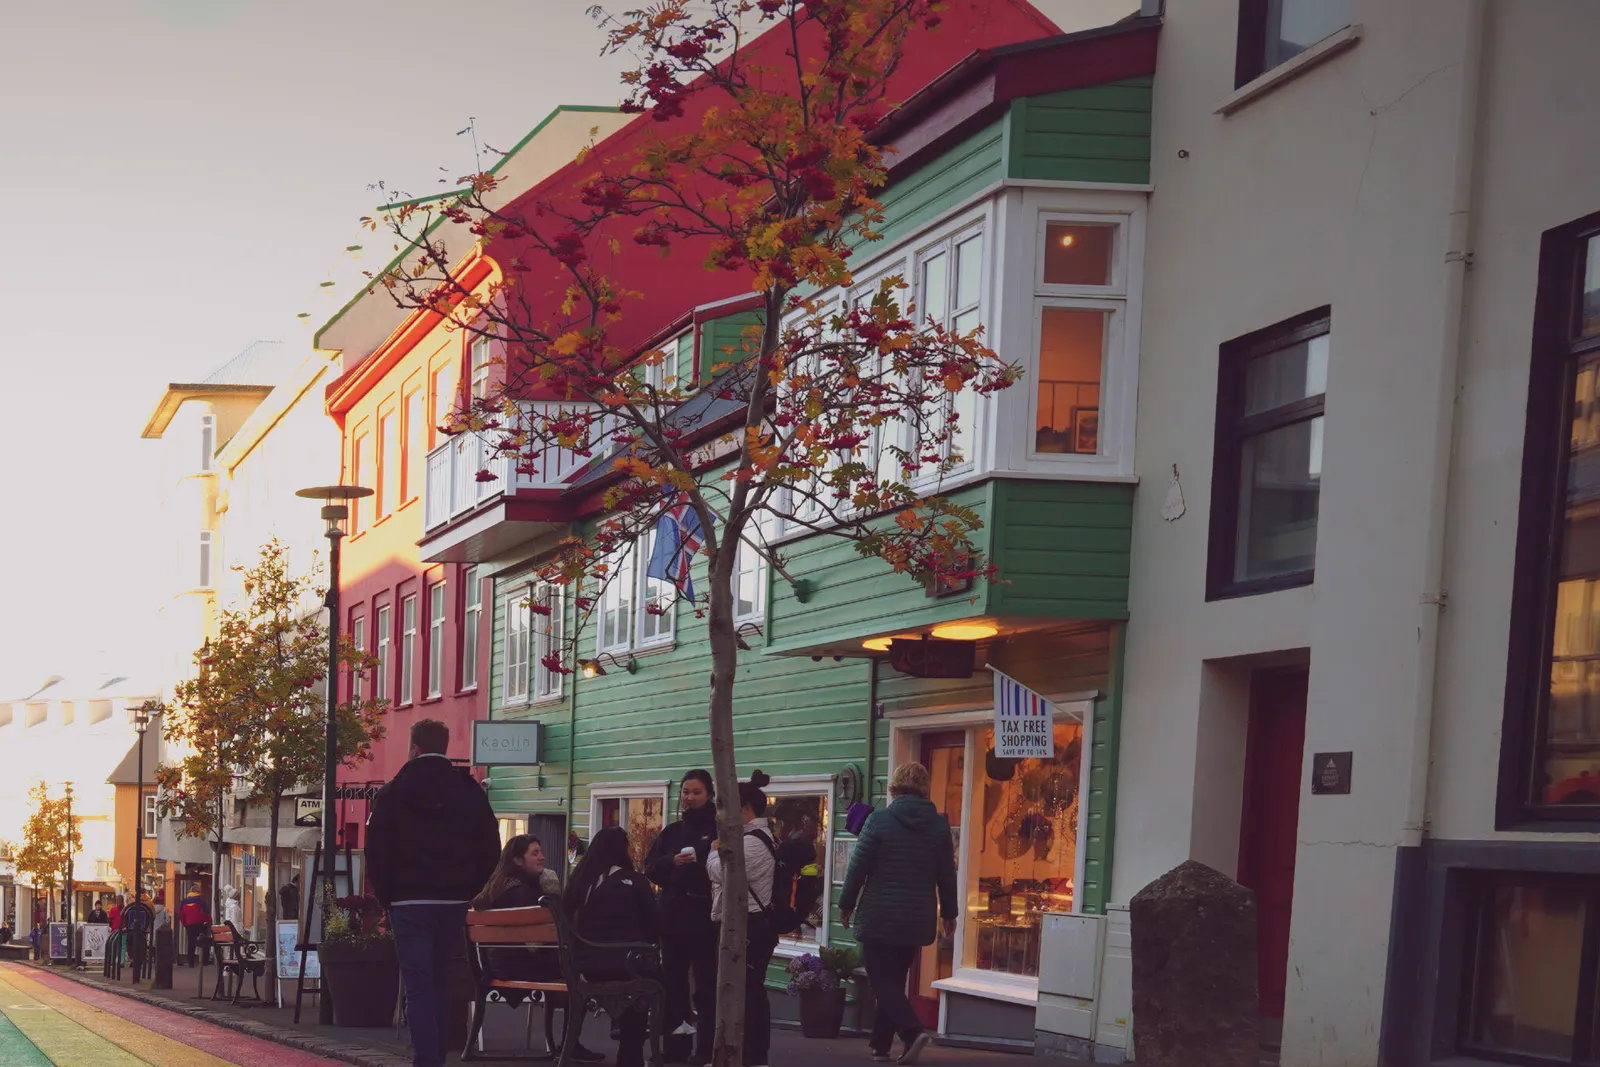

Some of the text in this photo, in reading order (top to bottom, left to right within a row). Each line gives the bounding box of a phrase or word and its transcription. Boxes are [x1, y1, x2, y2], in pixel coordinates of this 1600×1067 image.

[1001, 719, 1047, 733] TAX FREE
[481, 733, 531, 748] Kaolin
[1001, 735, 1047, 747] SHOPPING
[1002, 748, 1016, 756] SAVE
[1017, 748, 1025, 756] UP
[1027, 748, 1034, 756] TO
[301, 800, 321, 809] ATM
